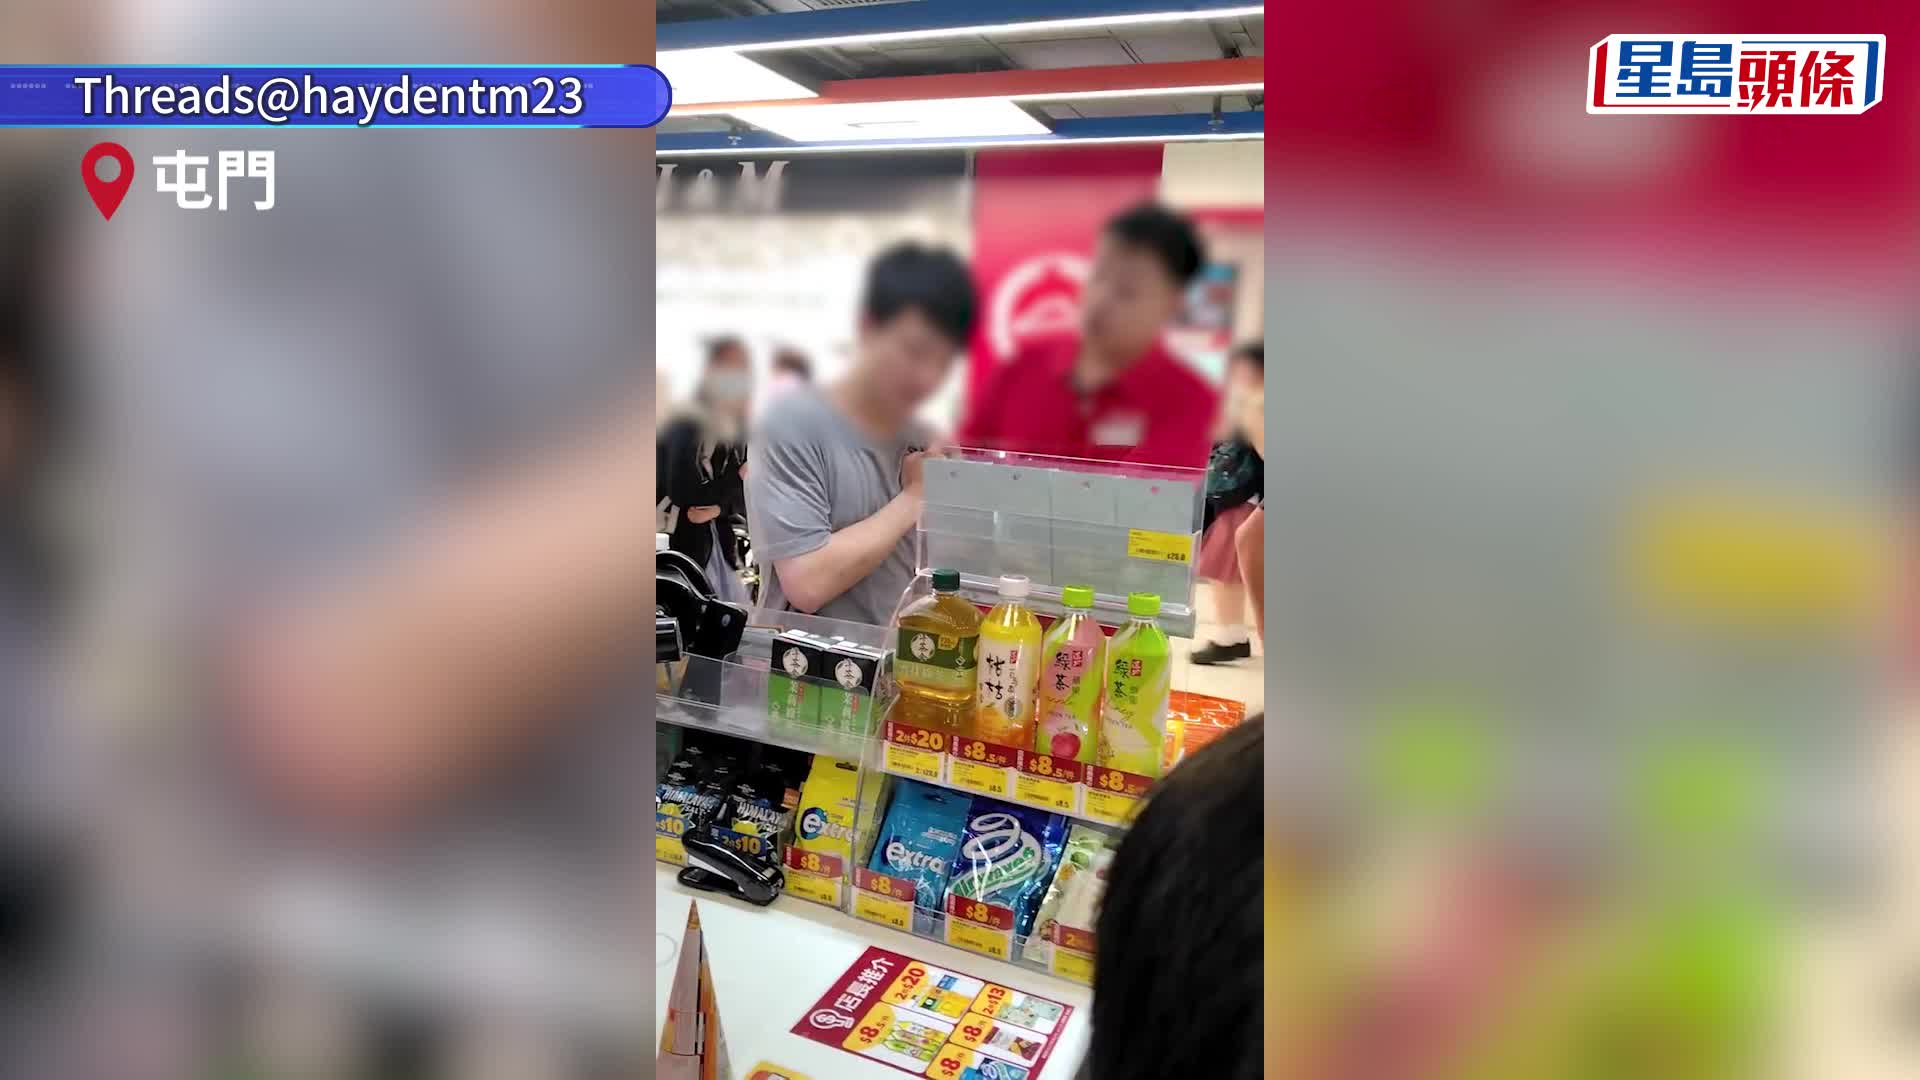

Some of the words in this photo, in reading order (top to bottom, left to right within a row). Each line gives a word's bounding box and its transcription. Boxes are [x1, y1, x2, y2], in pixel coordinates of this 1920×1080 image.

[1054, 651, 1071, 691] 綠茶
[1113, 658, 1129, 698] 綠茶
[886, 841, 945, 875] extra
[834, 957, 895, 1012] 店長推介
